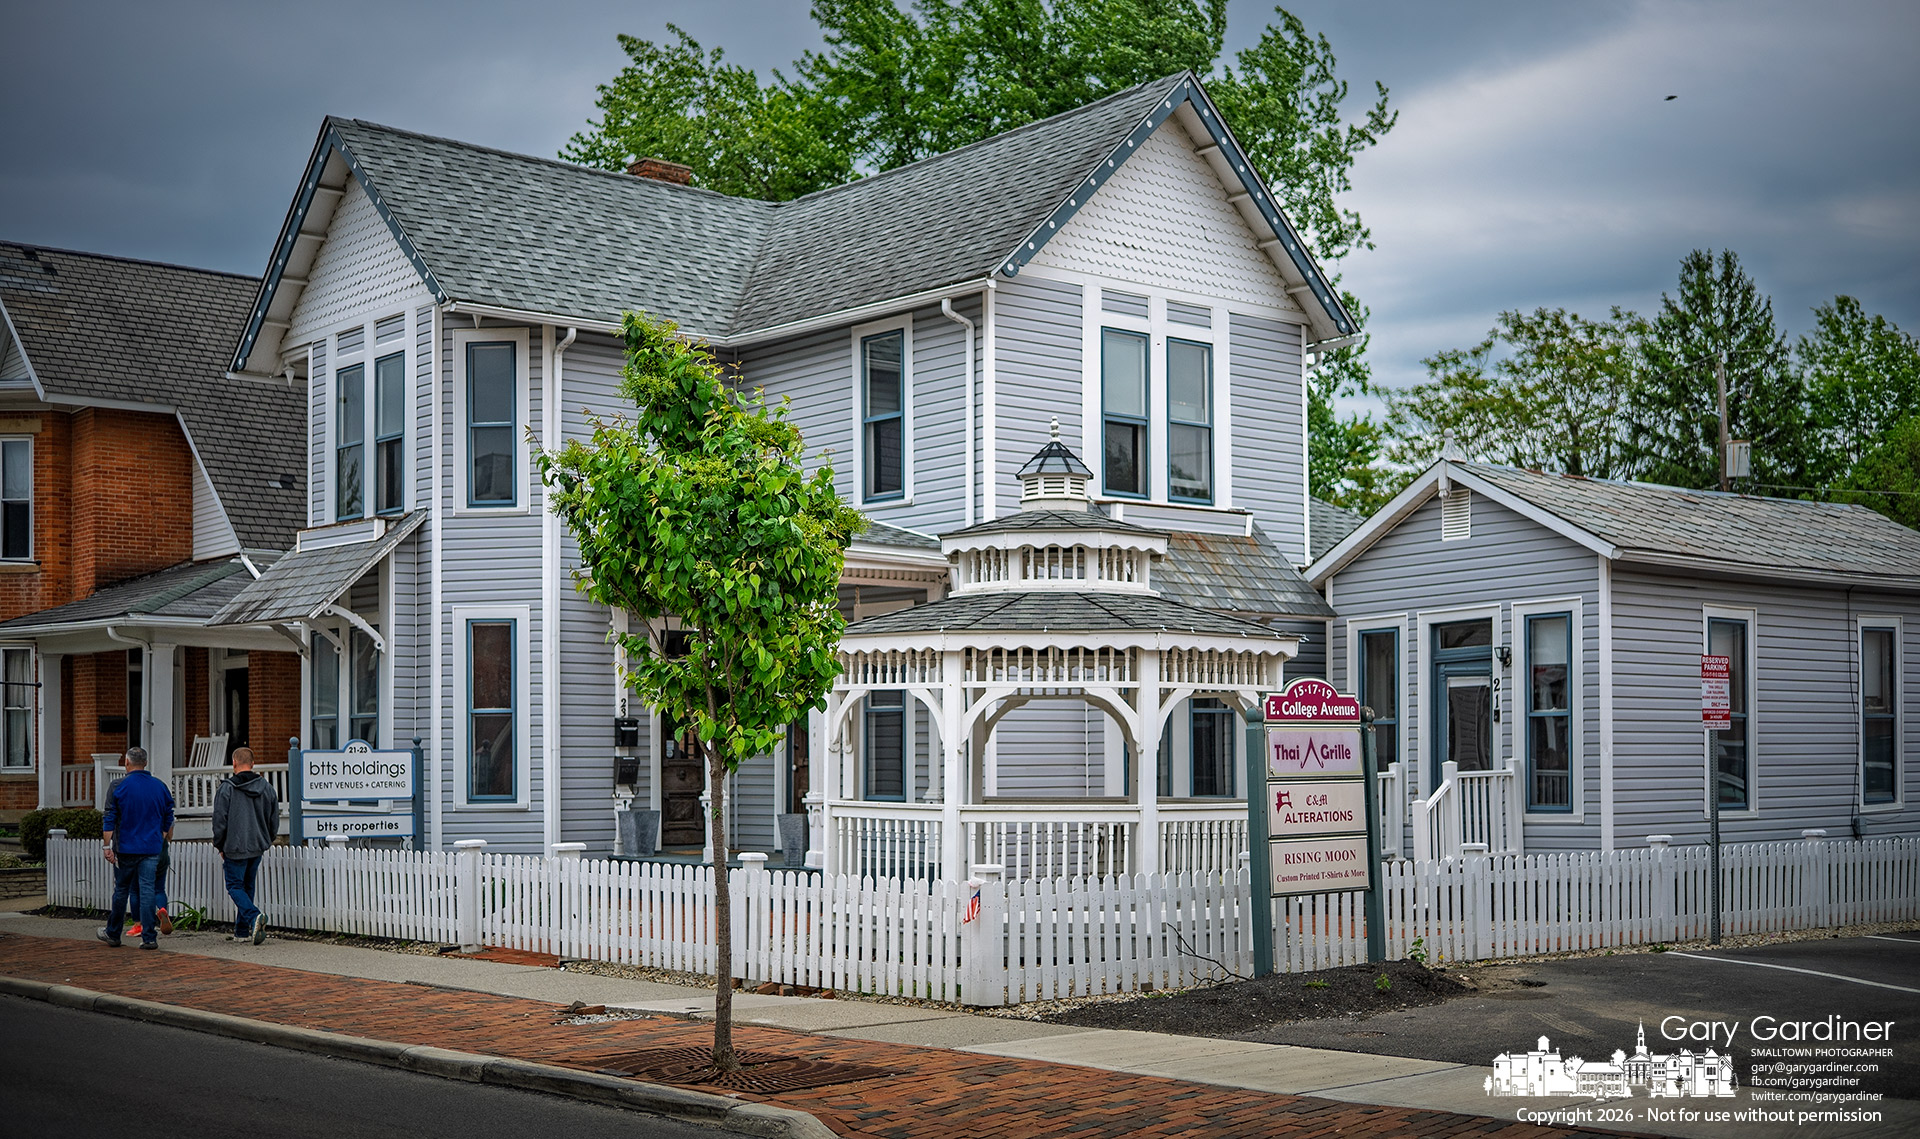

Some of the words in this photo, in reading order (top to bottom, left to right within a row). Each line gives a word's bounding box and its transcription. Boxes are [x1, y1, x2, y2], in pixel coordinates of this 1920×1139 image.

[1702, 656, 1729, 665] RESERVED
[1703, 663, 1727, 671] PARKING
[1270, 701, 1280, 715] E.
[1281, 701, 1318, 718] College
[1320, 702, 1356, 716] Avenue
[348, 746, 368, 754] 21-23
[1274, 744, 1300, 760] Thai
[1320, 743, 1351, 760] Grille
[309, 761, 338, 775] btts
[342, 761, 406, 778] holdings
[335, 781, 364, 789] VENUES
[371, 781, 406, 789] CATERING
[1305, 794, 1328, 806] C&M
[1284, 810, 1353, 824] ALTERATIONS
[317, 820, 338, 831] btts
[342, 820, 399, 833] properties
[1284, 851, 1321, 865] RISING
[1325, 849, 1357, 862] MOON
[1276, 874, 1298, 883] Custom
[1299, 872, 1320, 881] Printed
[1321, 870, 1343, 880] T-Shirts
[1344, 869, 1349, 878] &
[1350, 869, 1365, 878] More
